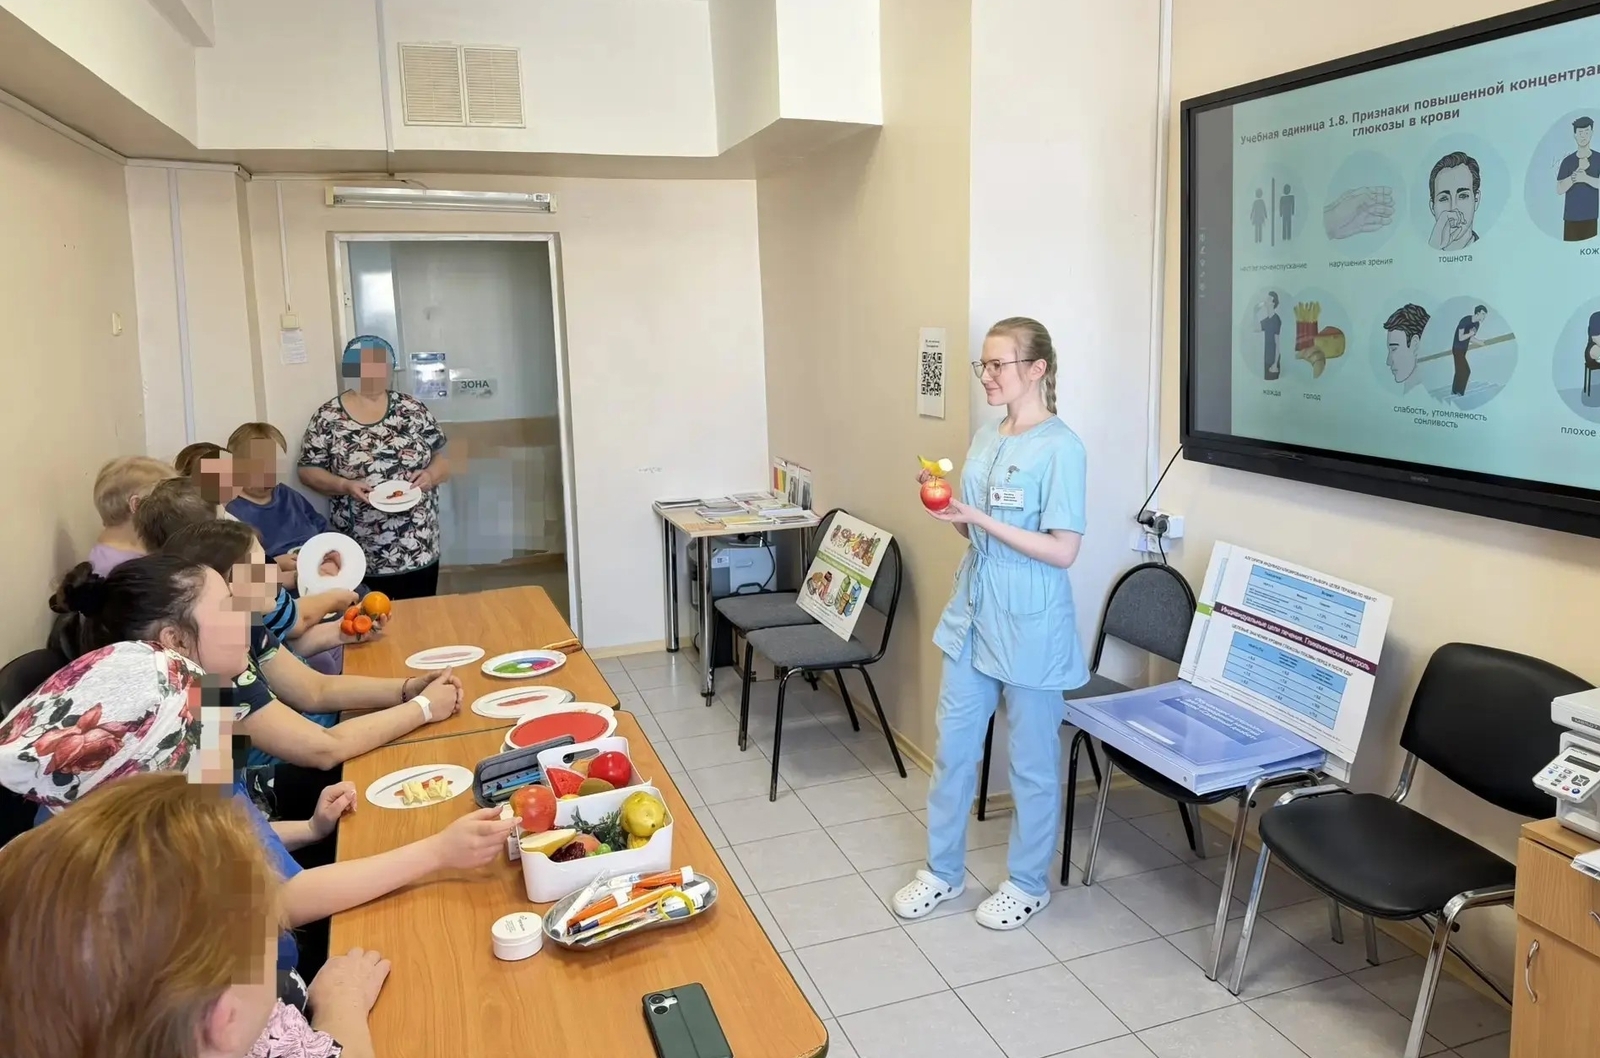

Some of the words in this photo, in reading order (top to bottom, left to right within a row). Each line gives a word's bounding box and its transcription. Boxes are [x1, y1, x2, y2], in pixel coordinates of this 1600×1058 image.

[1240, 130, 1279, 145] Учебная
[1282, 121, 1325, 137] единица
[1328, 114, 1348, 128] 1.8.
[1352, 102, 1409, 124] Признаки
[1414, 80, 1504, 111] повышенной
[1352, 118, 1405, 138] глюкозы
[1409, 116, 1417, 127] в
[1421, 107, 1460, 126] крови
[1328, 258, 1367, 269] нарушения
[1367, 257, 1394, 268] зрения
[1438, 253, 1473, 263] тошнота
[461, 380, 490, 389] ЗОНА
[1393, 405, 1429, 416] слабость,
[1431, 408, 1488, 422] утомляемость
[1413, 417, 1459, 429] сонливость
[1560, 426, 1597, 437] плохое
